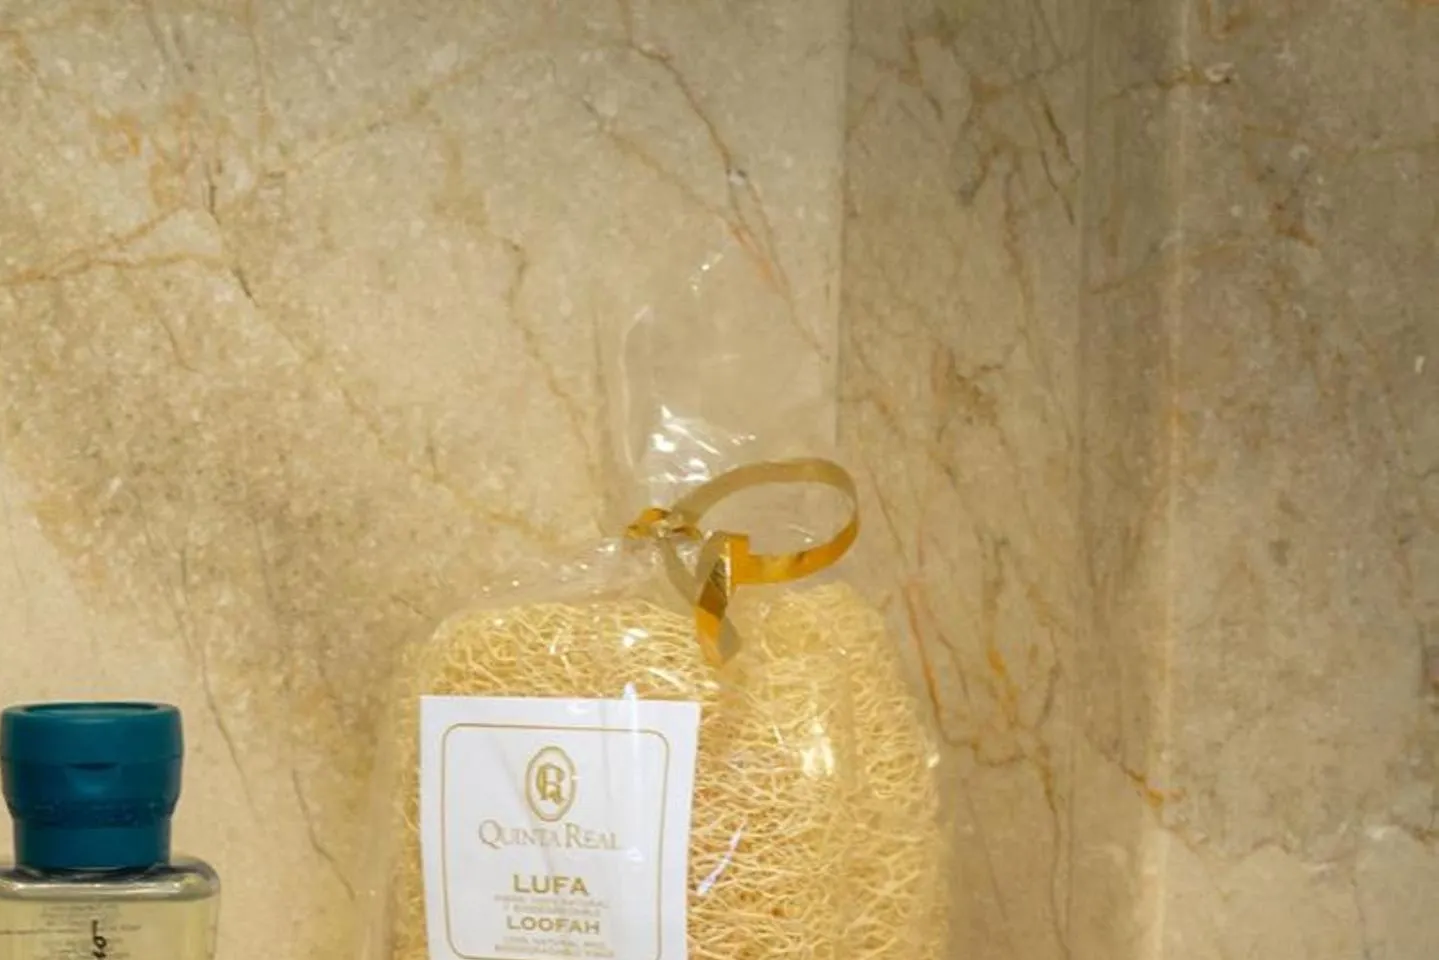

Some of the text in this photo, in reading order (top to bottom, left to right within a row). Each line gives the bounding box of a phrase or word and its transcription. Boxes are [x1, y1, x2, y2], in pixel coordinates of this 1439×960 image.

[478, 819, 623, 850] QUINTA REAL
[512, 873, 590, 896] LUFA
[505, 914, 601, 936] LOOFAH
